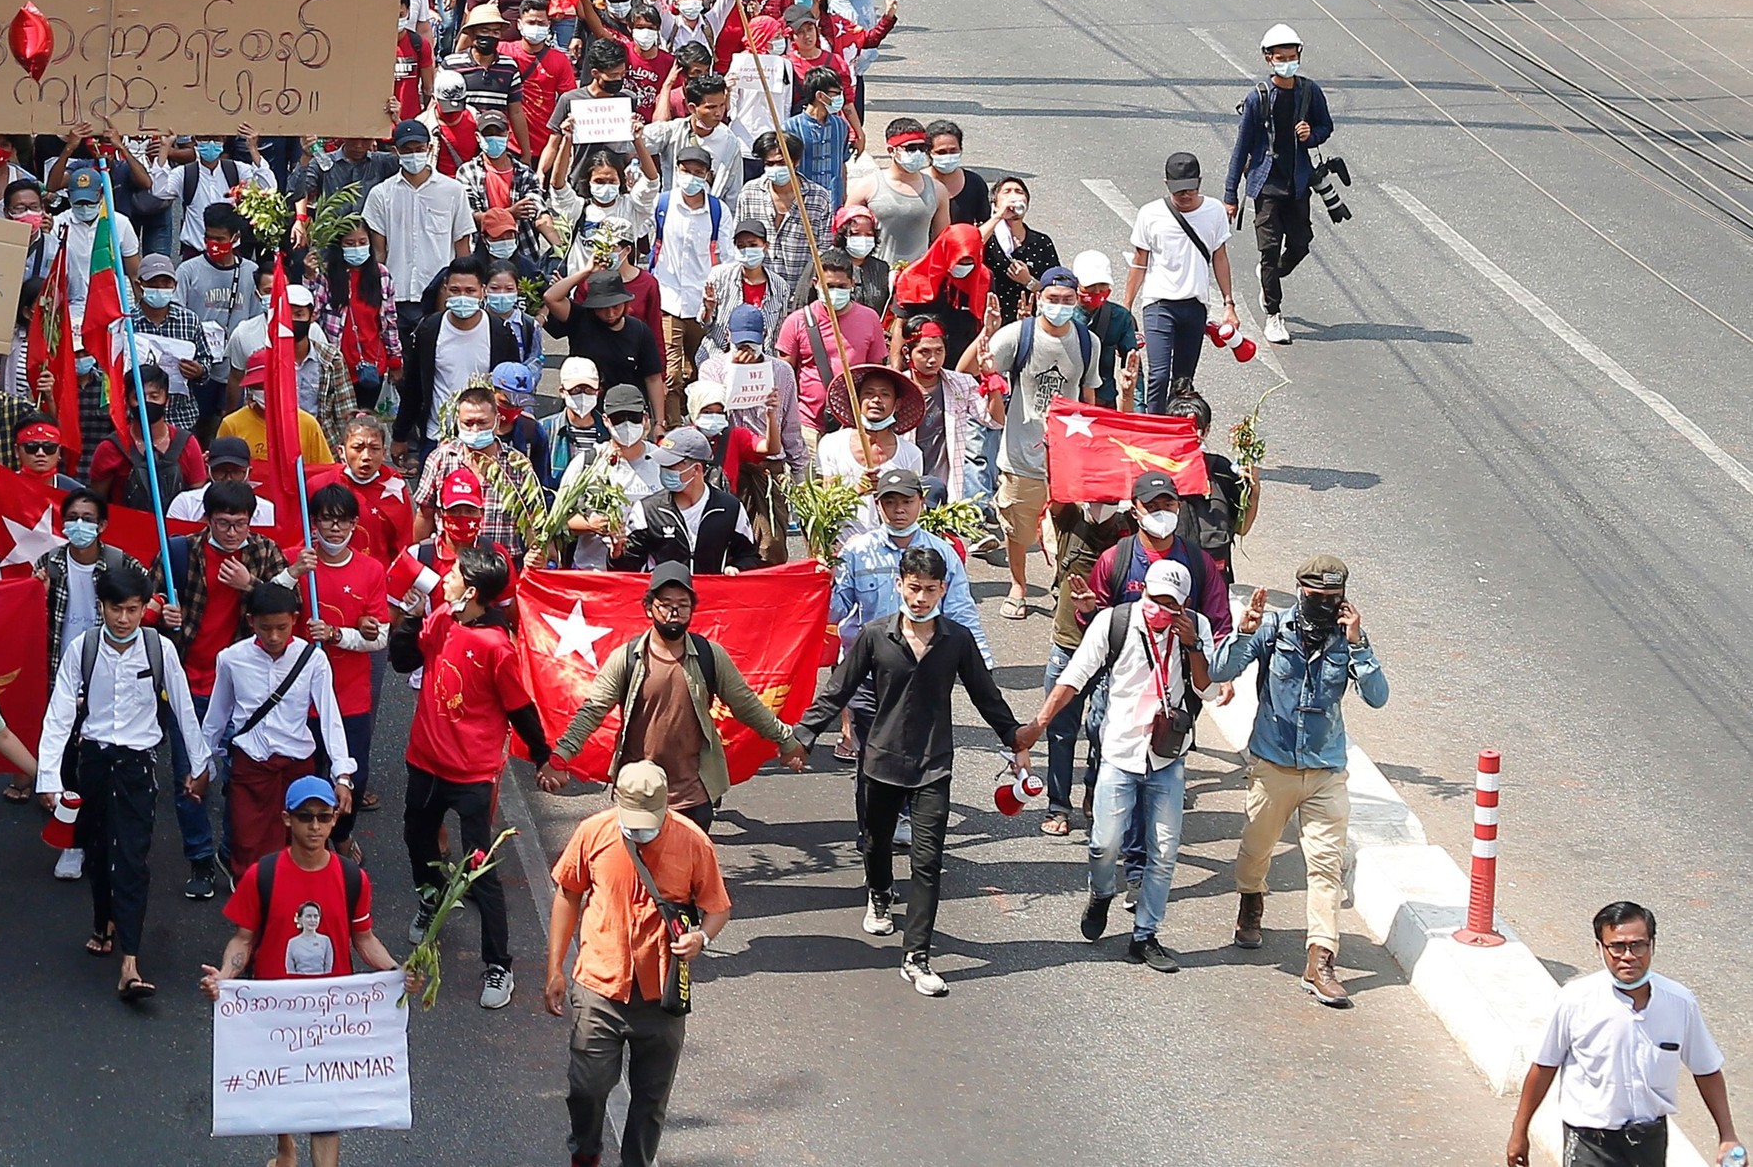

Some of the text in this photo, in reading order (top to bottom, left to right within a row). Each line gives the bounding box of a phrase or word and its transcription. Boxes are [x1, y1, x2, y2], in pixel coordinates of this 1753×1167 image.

[578, 117, 625, 126] MILITARY
[749, 371, 764, 379] WE
[741, 383, 766, 393] WANT
[452, 484, 472, 493] NLD
